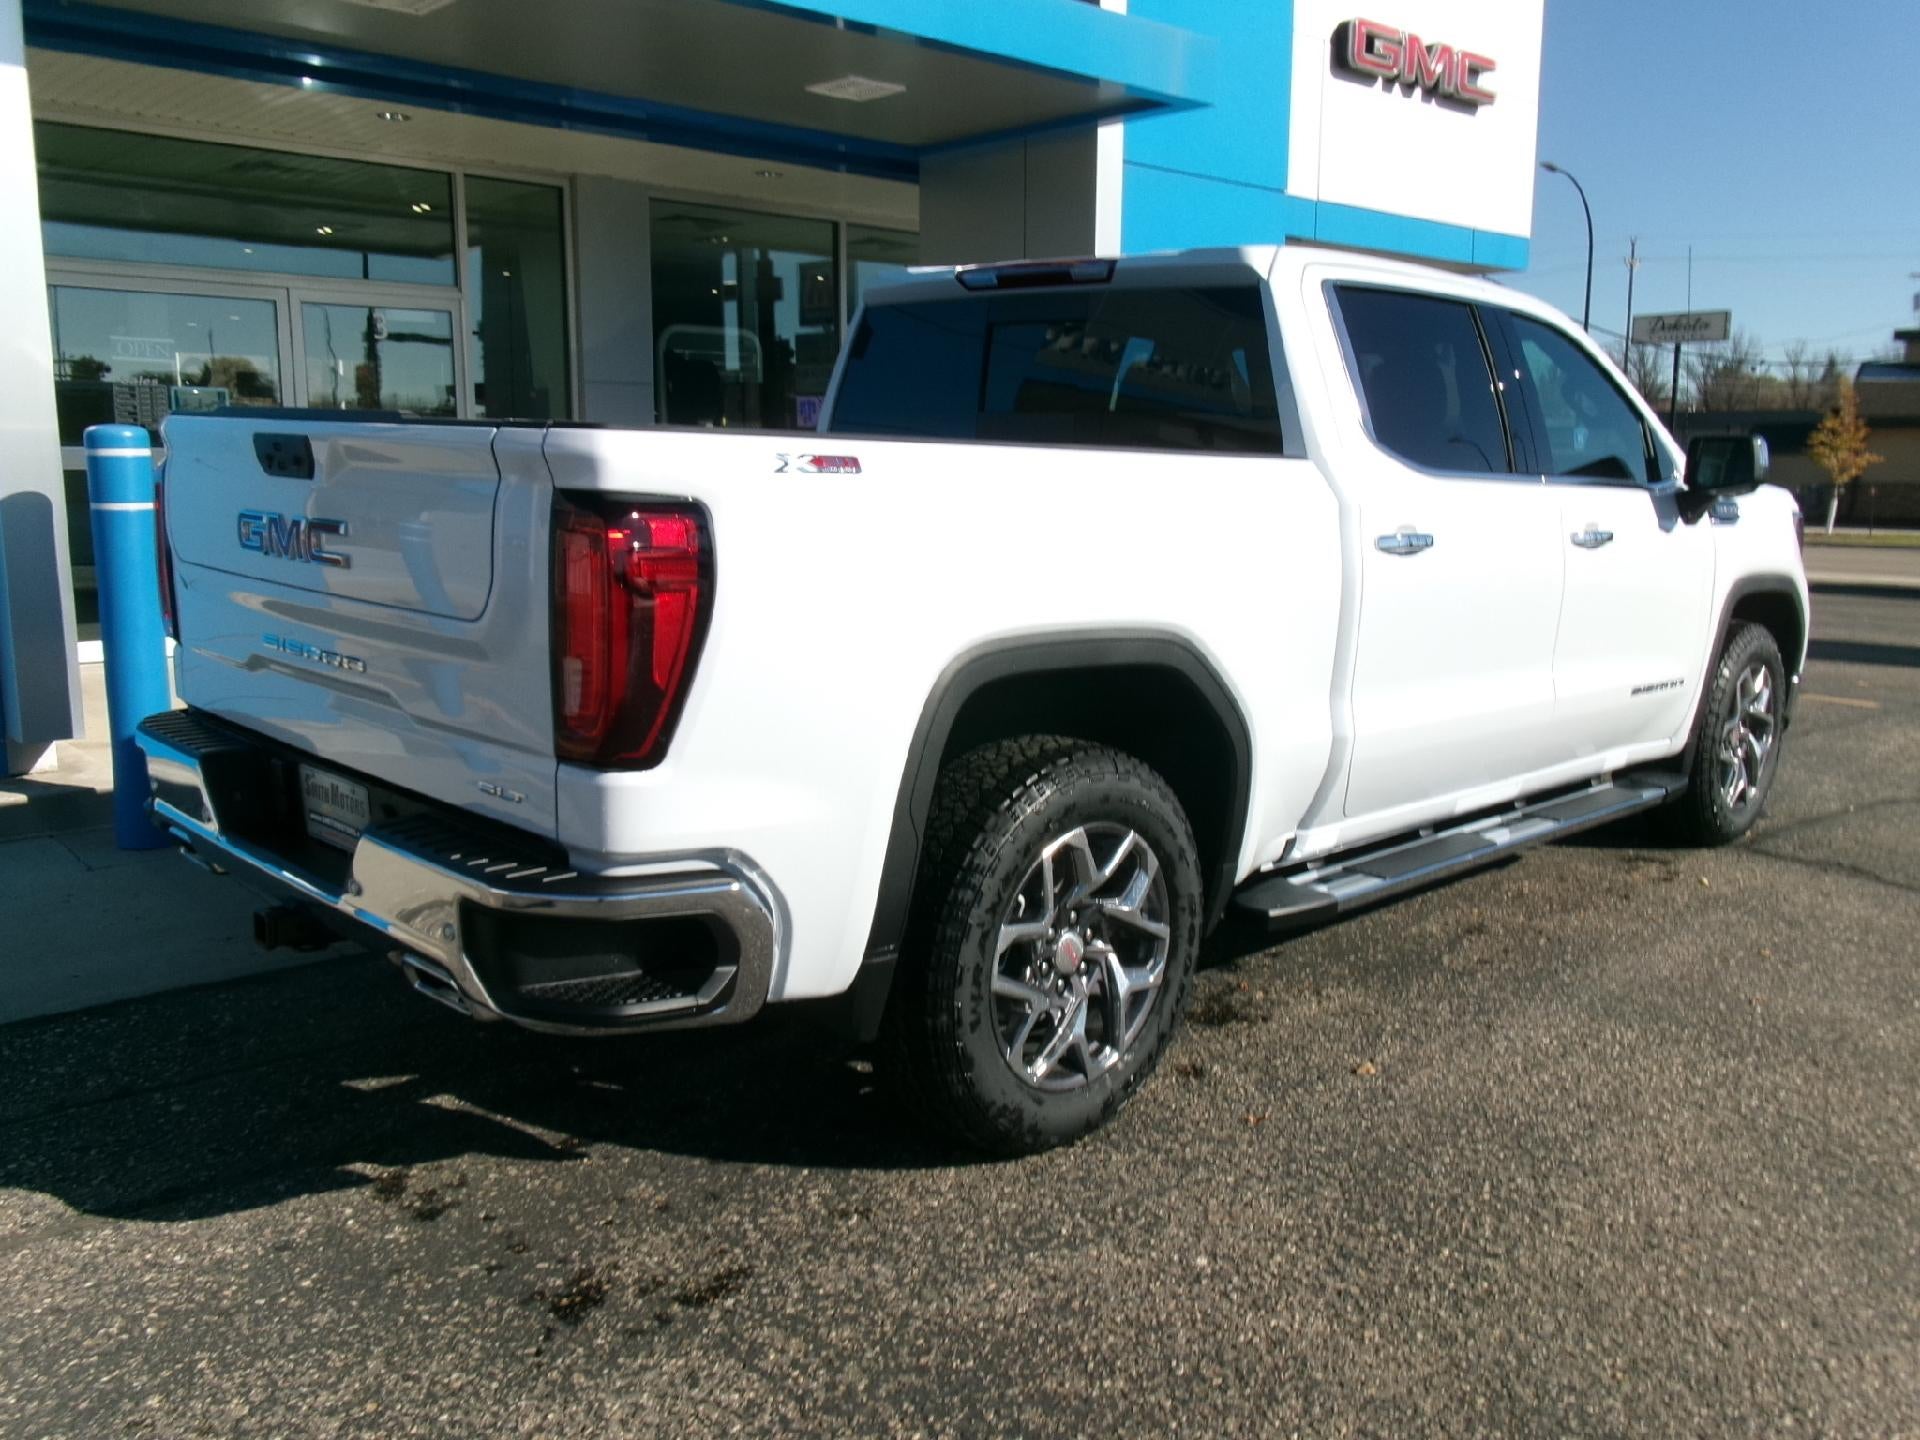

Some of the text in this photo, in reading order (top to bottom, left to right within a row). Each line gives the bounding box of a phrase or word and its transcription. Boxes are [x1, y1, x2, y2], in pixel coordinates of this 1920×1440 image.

[1346, 16, 1498, 106] GMC
[119, 342, 170, 356] OPEN
[238, 509, 352, 569] GMC
[262, 631, 368, 674] SIERRA
[477, 780, 529, 804] SLT
